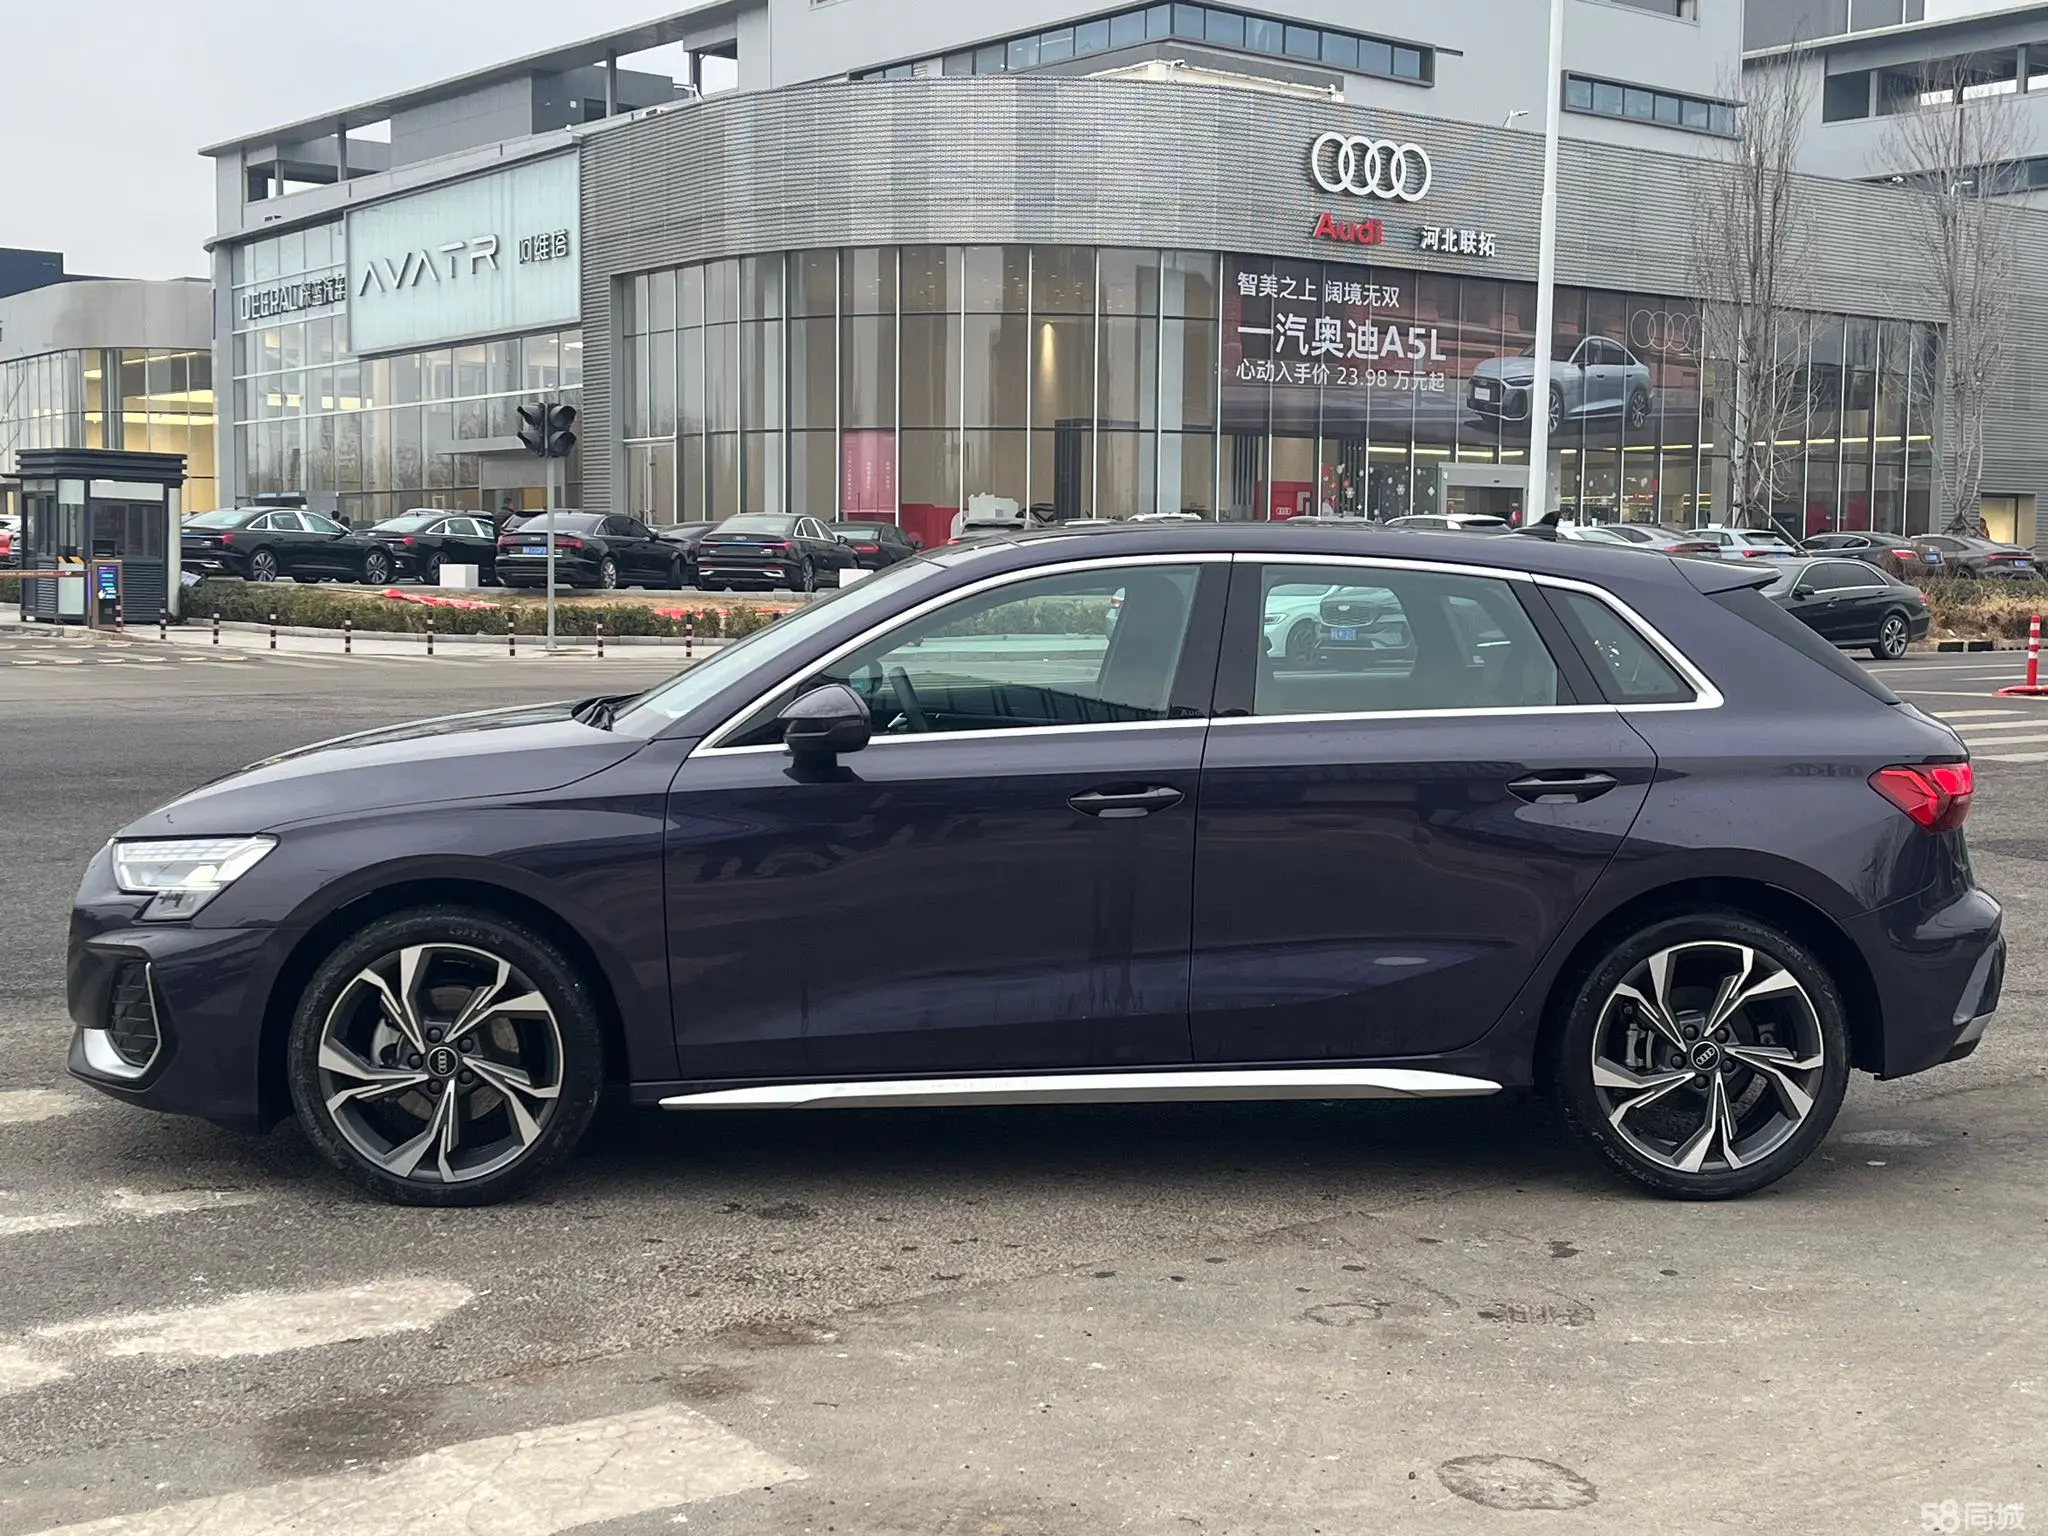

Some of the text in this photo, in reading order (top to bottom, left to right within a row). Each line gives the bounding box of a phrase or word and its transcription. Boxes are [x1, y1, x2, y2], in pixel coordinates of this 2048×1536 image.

[1312, 211, 1385, 247] Audi
[1420, 226, 1496, 257] 河北联拓
[359, 233, 500, 297] AVATR
[1237, 271, 1400, 308] 智美之上 阔境无双
[1237, 313, 1447, 361] 一汽奥迪A5L
[1236, 358, 1445, 392] 心动入手价 23.98 万元起
